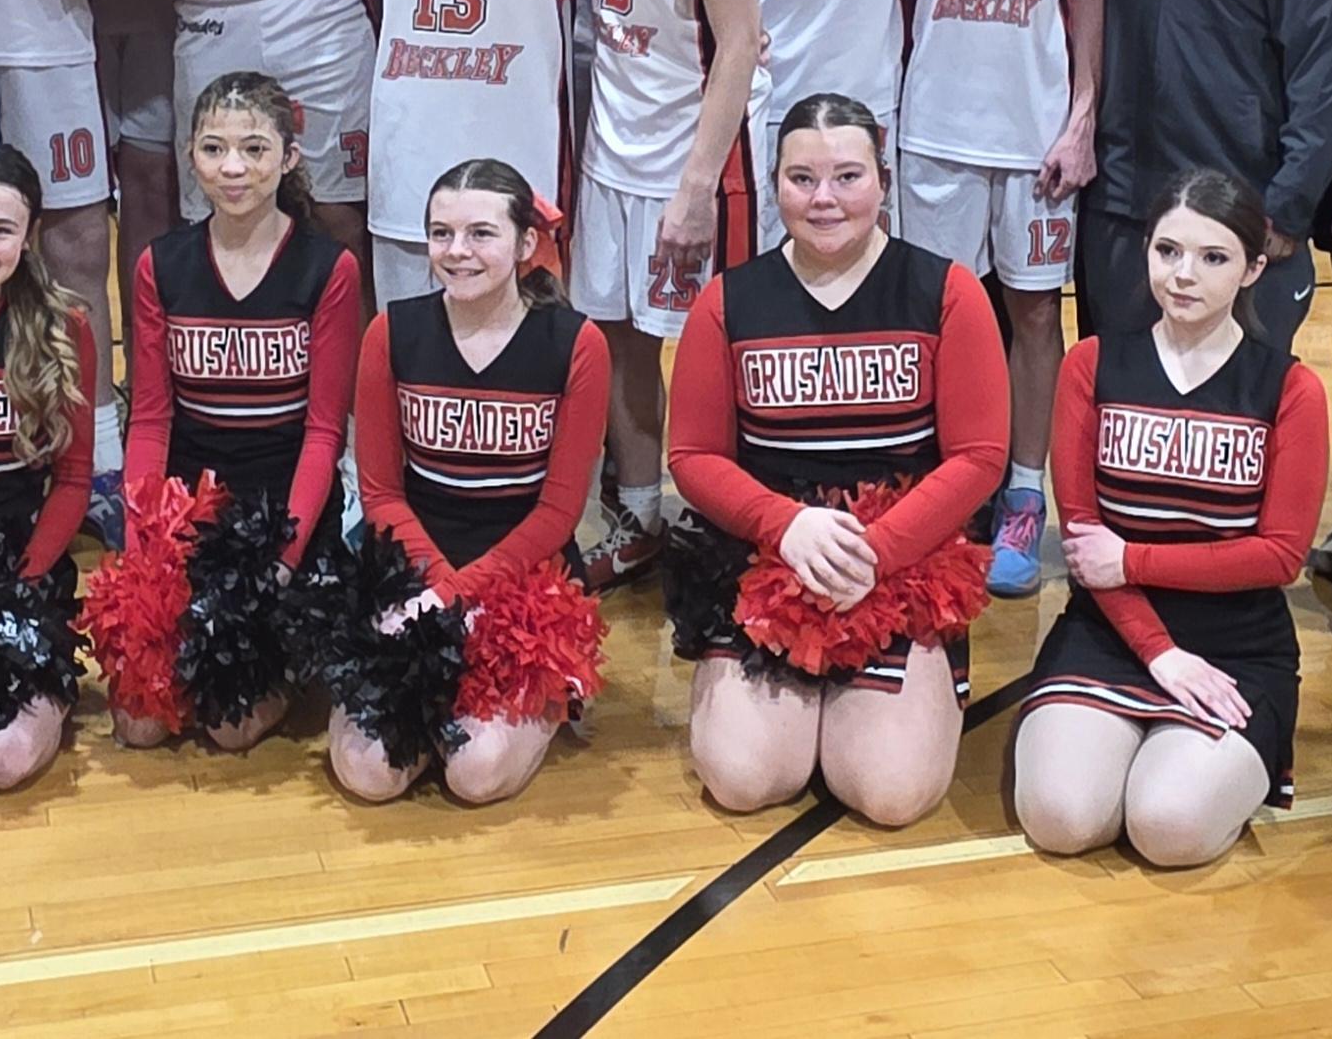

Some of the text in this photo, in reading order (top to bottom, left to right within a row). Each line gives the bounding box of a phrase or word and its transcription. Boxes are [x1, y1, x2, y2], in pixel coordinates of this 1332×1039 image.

[381, 38, 525, 85] BECKLEY
[49, 127, 96, 183] 10
[340, 129, 368, 179] 3
[1027, 217, 1072, 266] 12
[648, 255, 702, 312] 25
[741, 343, 920, 408] CRUSADERS
[1098, 406, 1268, 486] CRUSADERS
